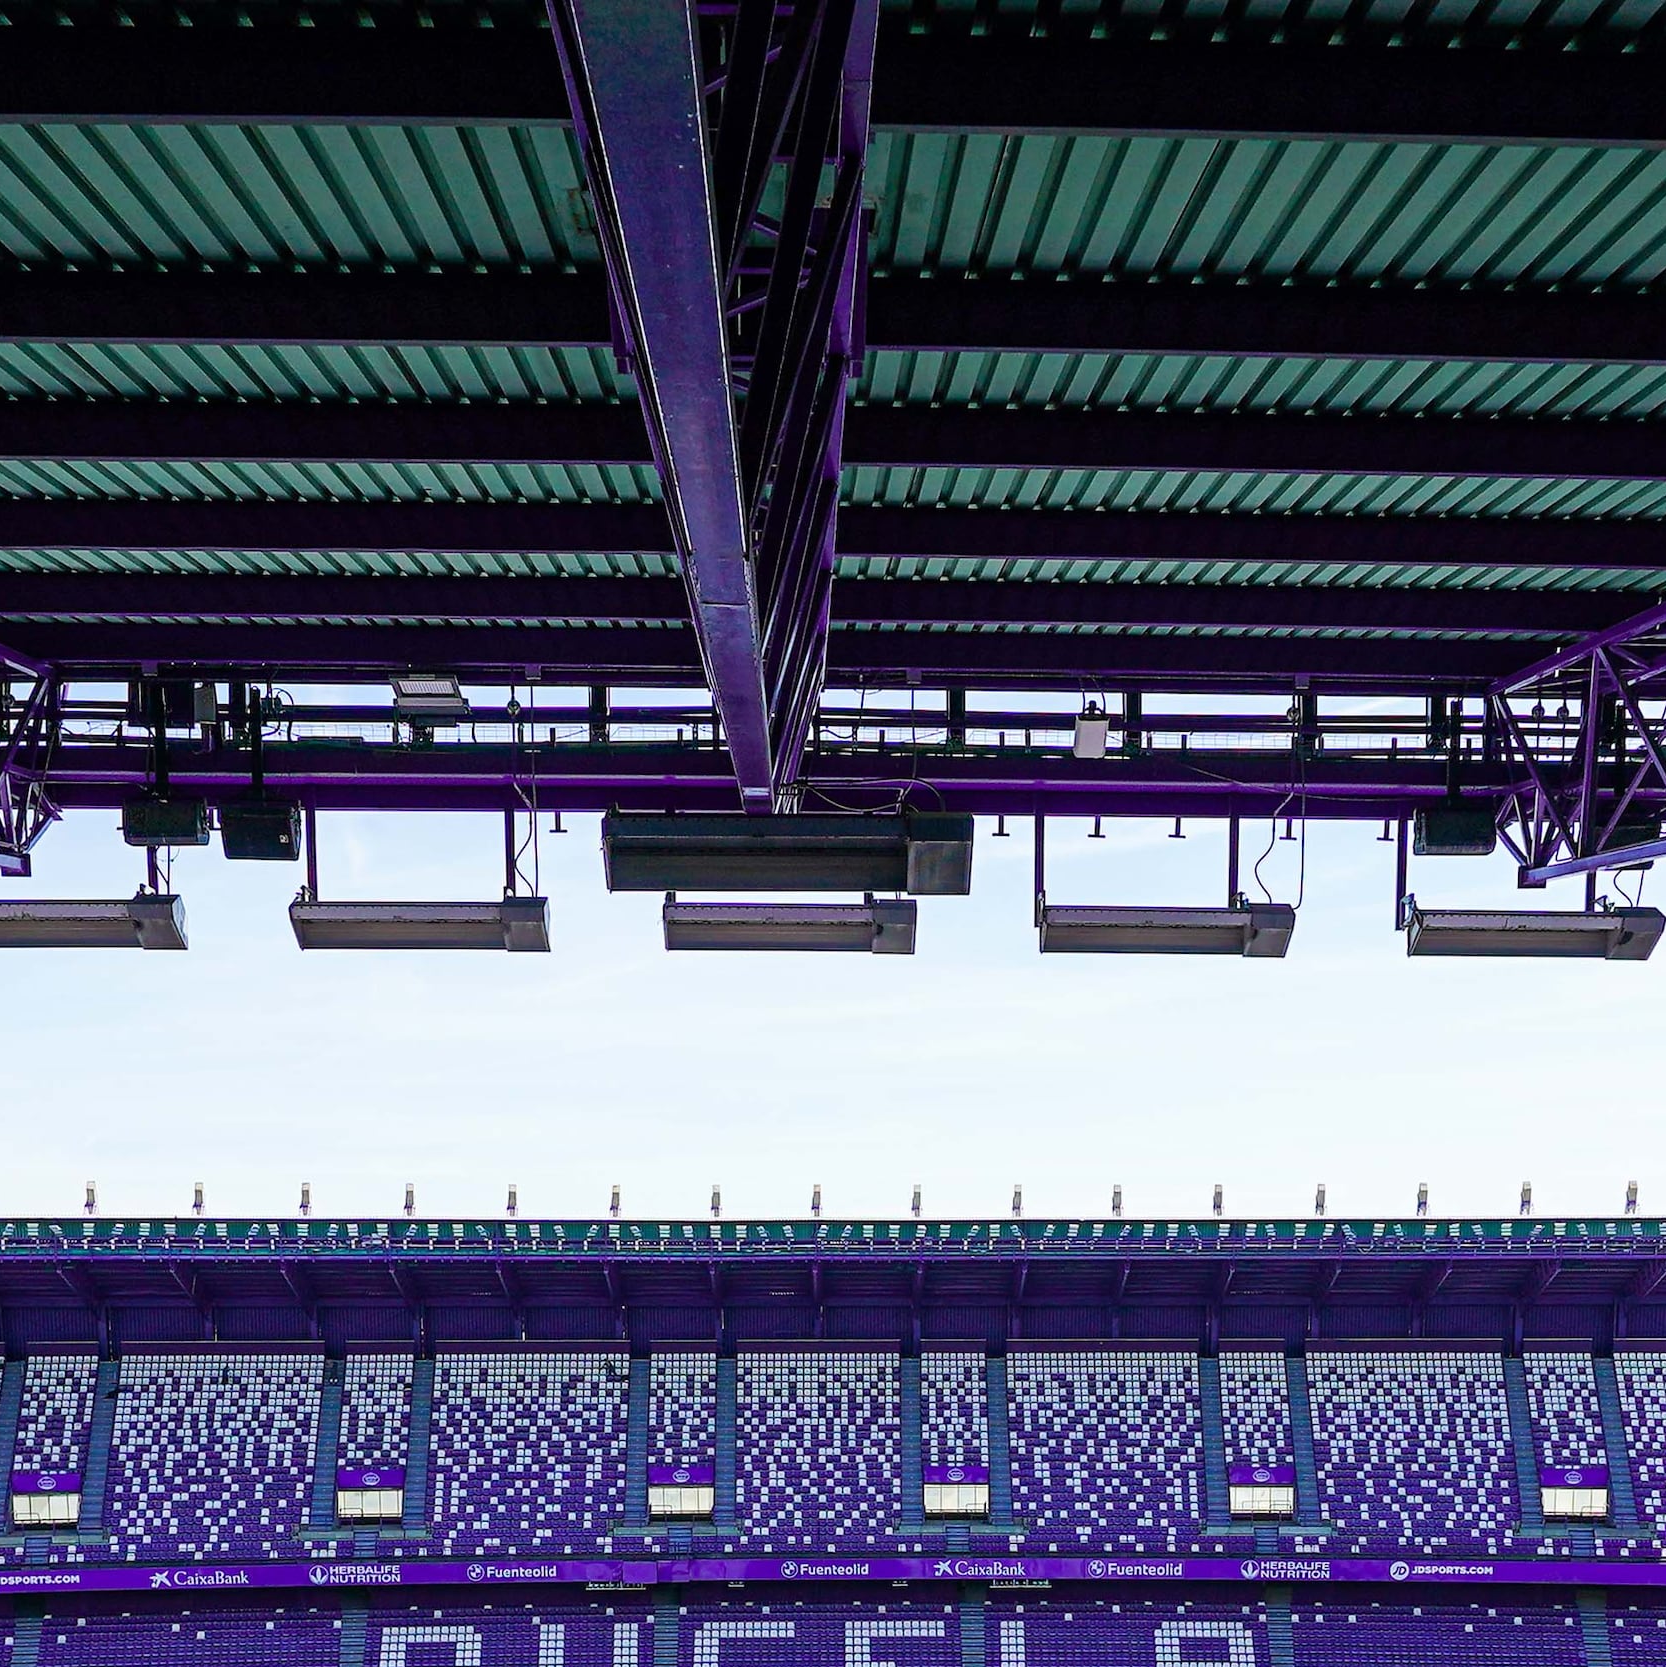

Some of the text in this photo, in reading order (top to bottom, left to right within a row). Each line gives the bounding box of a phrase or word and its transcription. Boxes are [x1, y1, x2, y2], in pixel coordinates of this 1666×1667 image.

[329, 1564, 400, 1575] HERBALIFE
[487, 1565, 557, 1578] Fuenteolid
[799, 1562, 869, 1576] Fuenteolid
[954, 1560, 1026, 1577] CaixaBank
[1107, 1562, 1183, 1577] Fuenteolid
[1260, 1561, 1330, 1571] HERBALIFE
[1411, 1565, 1494, 1575] JDSPORTS.COM
[173, 1570, 249, 1587] CaixaBank
[329, 1574, 401, 1584] NUTRITION
[1260, 1570, 1330, 1579] NUTRITION
